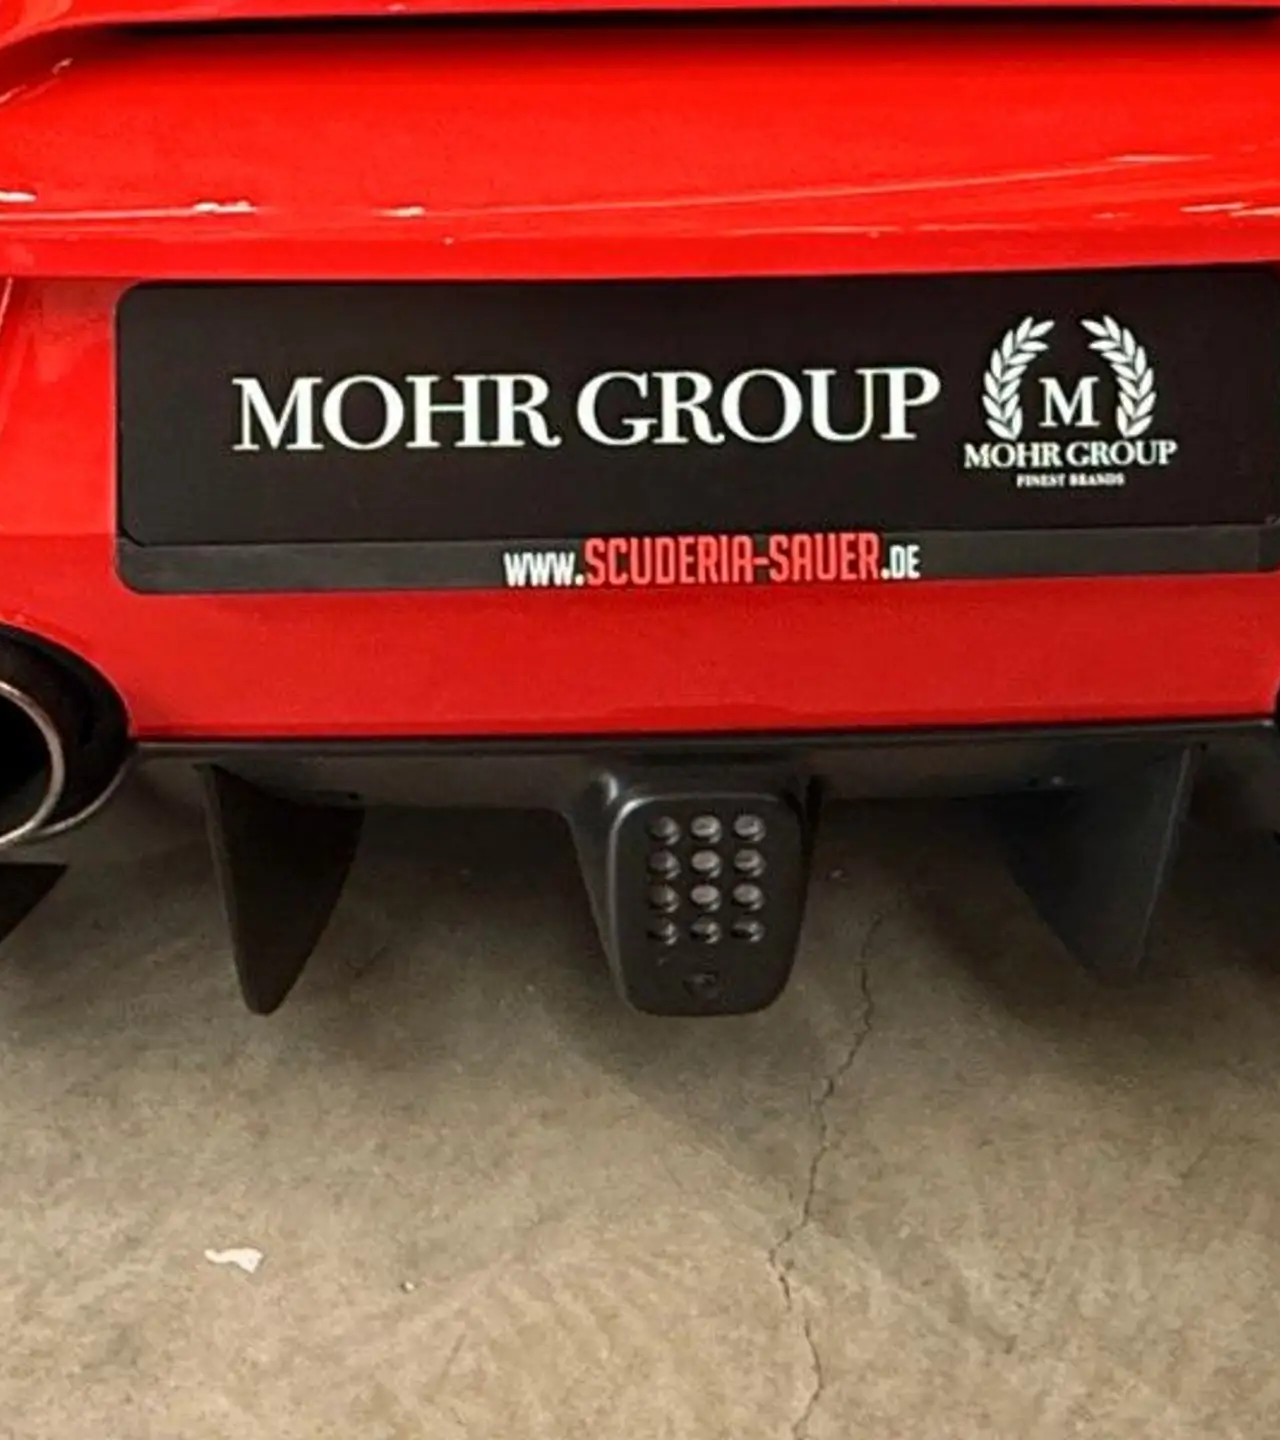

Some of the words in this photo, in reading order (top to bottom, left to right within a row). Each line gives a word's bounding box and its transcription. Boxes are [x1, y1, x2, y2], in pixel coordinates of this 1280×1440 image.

[232, 374, 561, 451] MOHR
[576, 367, 942, 446] GROUP
[1037, 375, 1102, 428] M
[964, 442, 1063, 470] MOHR
[1065, 439, 1178, 467] GROUP
[1016, 473, 1066, 488] FINEST
[1069, 472, 1126, 487] BRANDS
